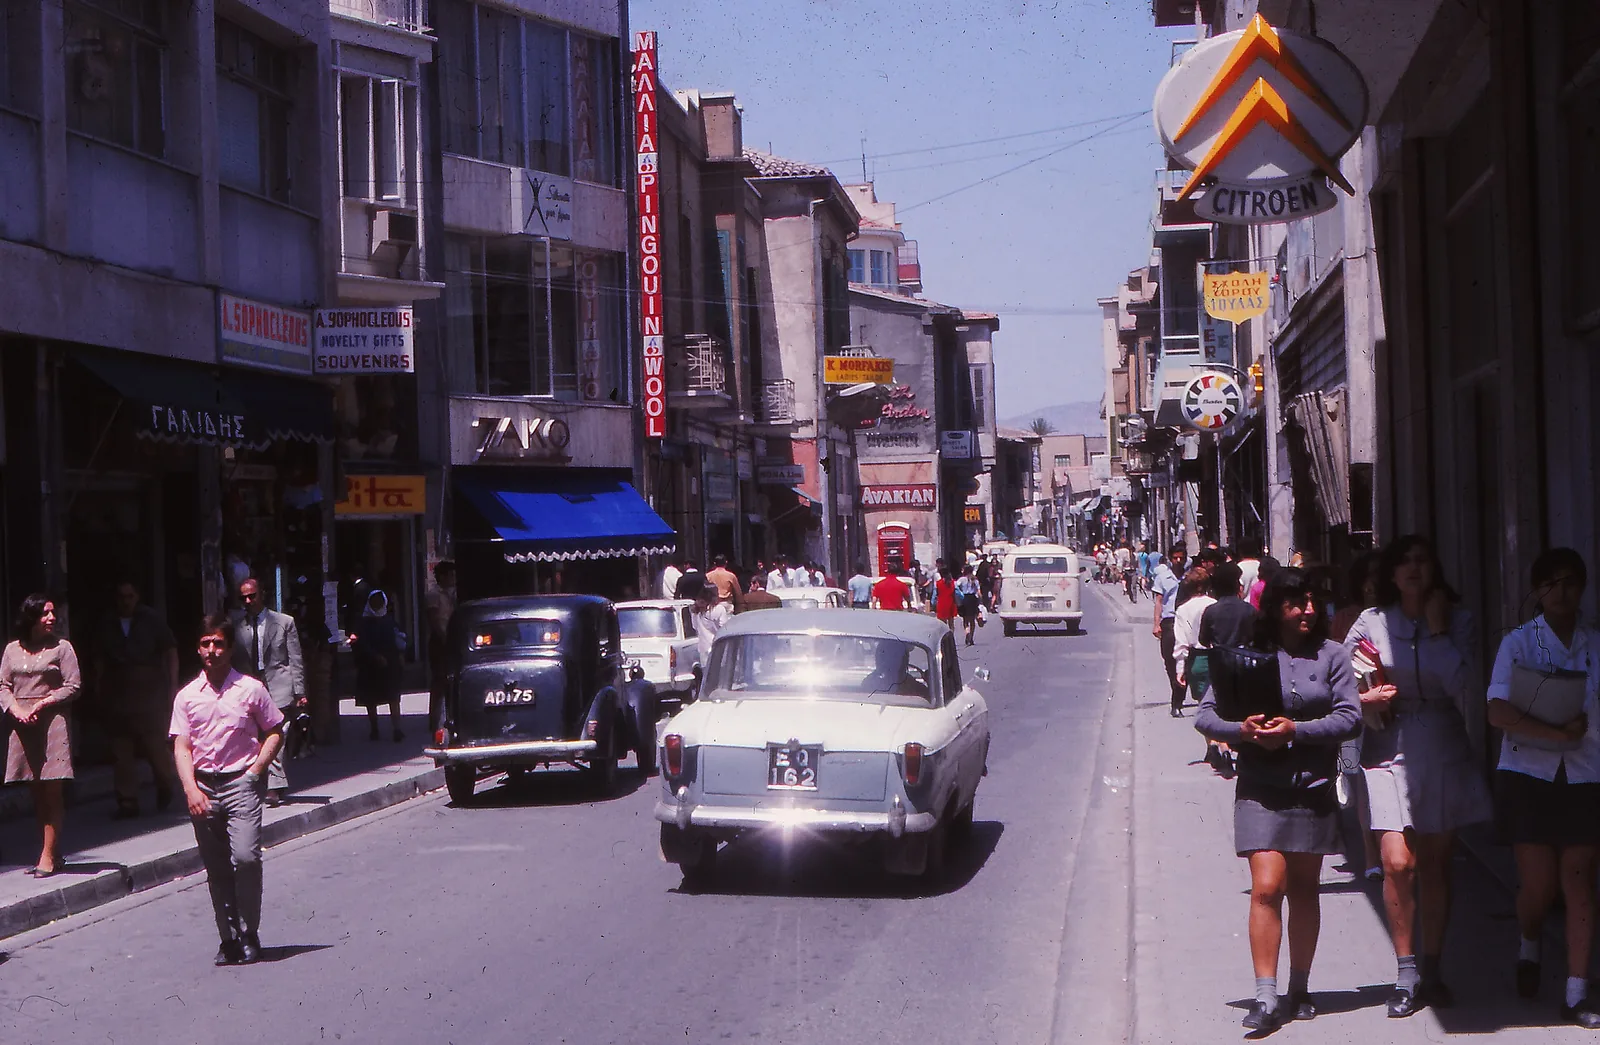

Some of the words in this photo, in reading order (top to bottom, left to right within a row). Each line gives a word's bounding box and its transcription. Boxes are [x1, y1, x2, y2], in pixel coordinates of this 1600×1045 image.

[1213, 182, 1317, 217] CITROEN
[640, 174, 660, 335] PINGOUIN
[321, 334, 367, 348] NOVELTY
[373, 333, 404, 348] GIFTS
[317, 354, 410, 369] SOUVENIRS
[645, 357, 663, 436] WOOL
[861, 486, 934, 505] AVAKIAN
[771, 767, 815, 786] 162
